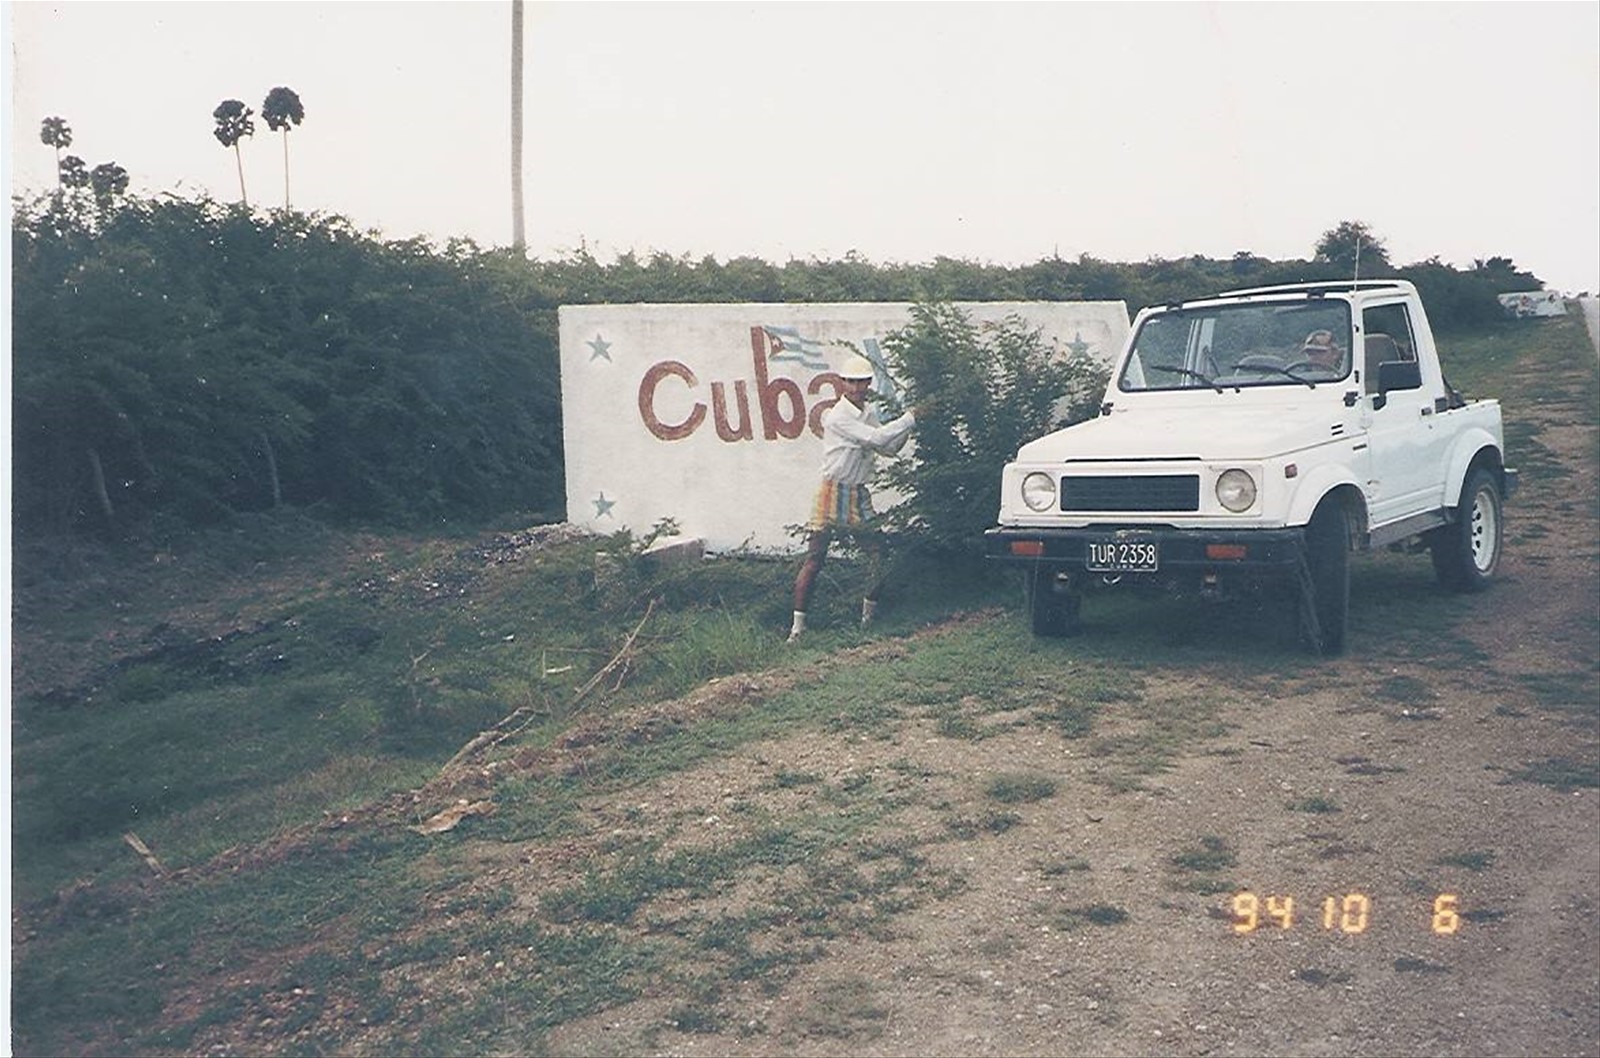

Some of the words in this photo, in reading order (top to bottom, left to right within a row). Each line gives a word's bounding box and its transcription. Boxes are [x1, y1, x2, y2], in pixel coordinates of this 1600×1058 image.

[638, 326, 844, 442] Cuba
[1089, 544, 1115, 563] TUR
[1119, 544, 1155, 564] 2358
